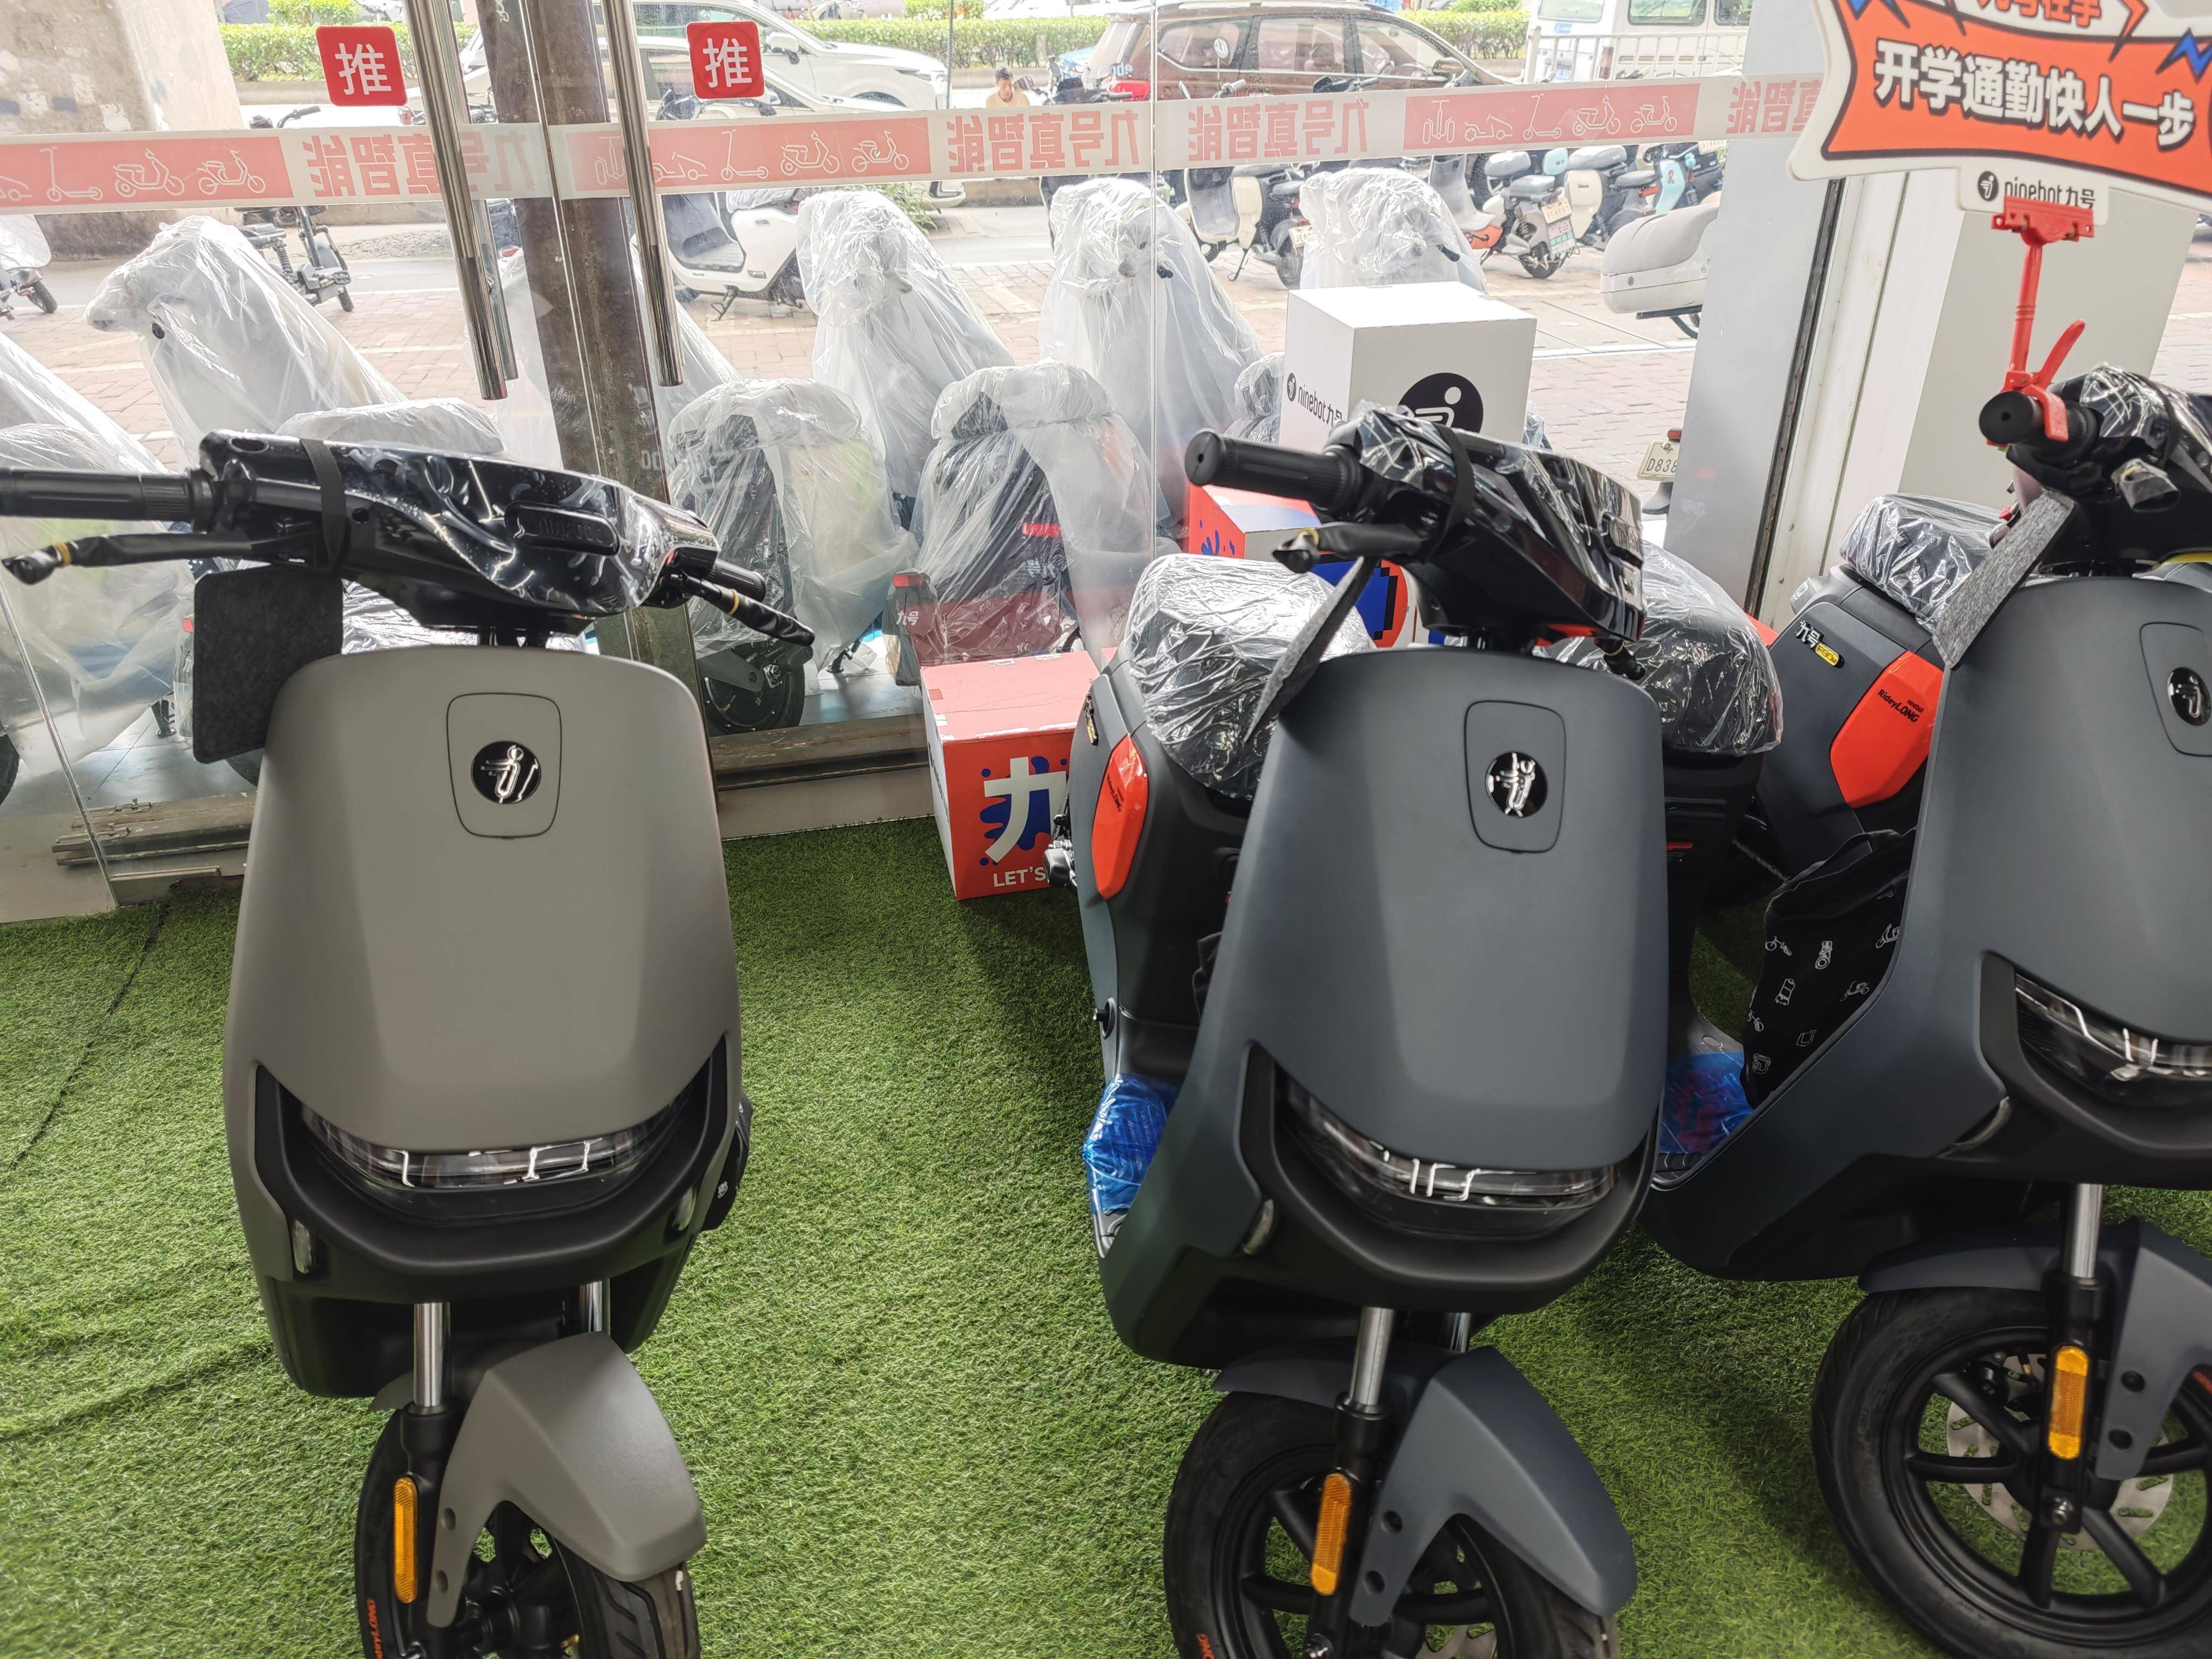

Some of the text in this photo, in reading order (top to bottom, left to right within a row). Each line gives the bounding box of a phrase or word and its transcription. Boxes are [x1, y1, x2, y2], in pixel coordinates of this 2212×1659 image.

[335, 43, 392, 96] 推
[702, 37, 753, 89] 推
[1874, 38, 2196, 148] 开学通勤快人一步
[1298, 383, 1326, 422] ninebot
[896, 610, 919, 626] 九号
[1796, 621, 1820, 648] 九号
[1877, 689, 1920, 723] RideyLONG
[993, 866, 1047, 887] LET'S
